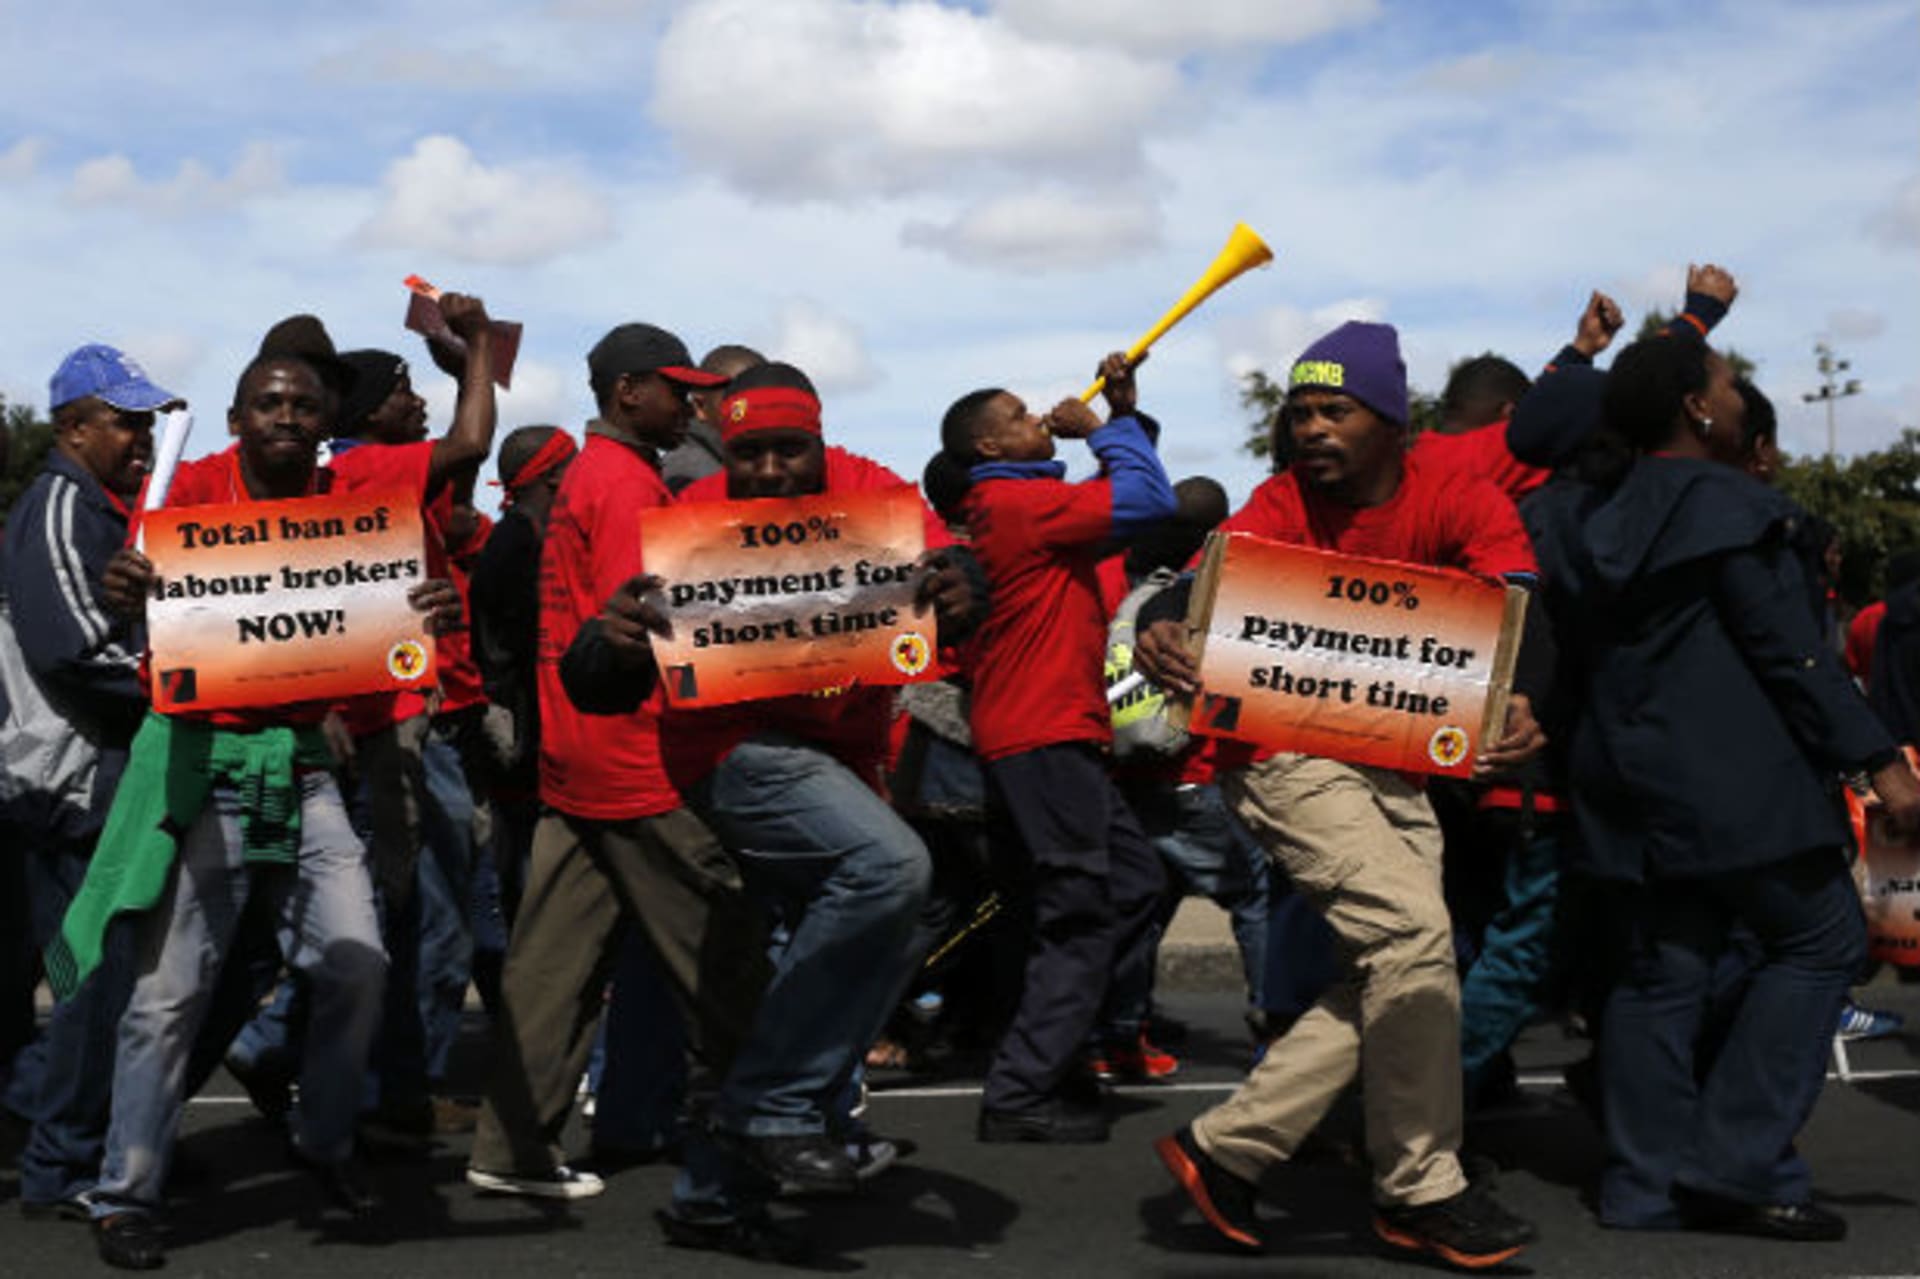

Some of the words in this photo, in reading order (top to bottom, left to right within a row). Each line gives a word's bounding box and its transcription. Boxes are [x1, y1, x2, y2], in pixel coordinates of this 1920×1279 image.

[177, 519, 269, 549] Total
[279, 517, 345, 540] ban
[354, 507, 390, 532] of
[740, 516, 840, 548] 100%
[154, 574, 271, 600] labour
[280, 558, 419, 589] brokers
[670, 564, 844, 607] payment
[854, 559, 914, 586] for
[1326, 575, 1419, 610] 100%
[237, 609, 346, 643] NOW!
[693, 616, 799, 647] short
[810, 606, 898, 636] time
[1240, 615, 1411, 660] payment
[1419, 637, 1475, 669] for
[1249, 665, 1358, 703] short
[1366, 681, 1449, 716] time
